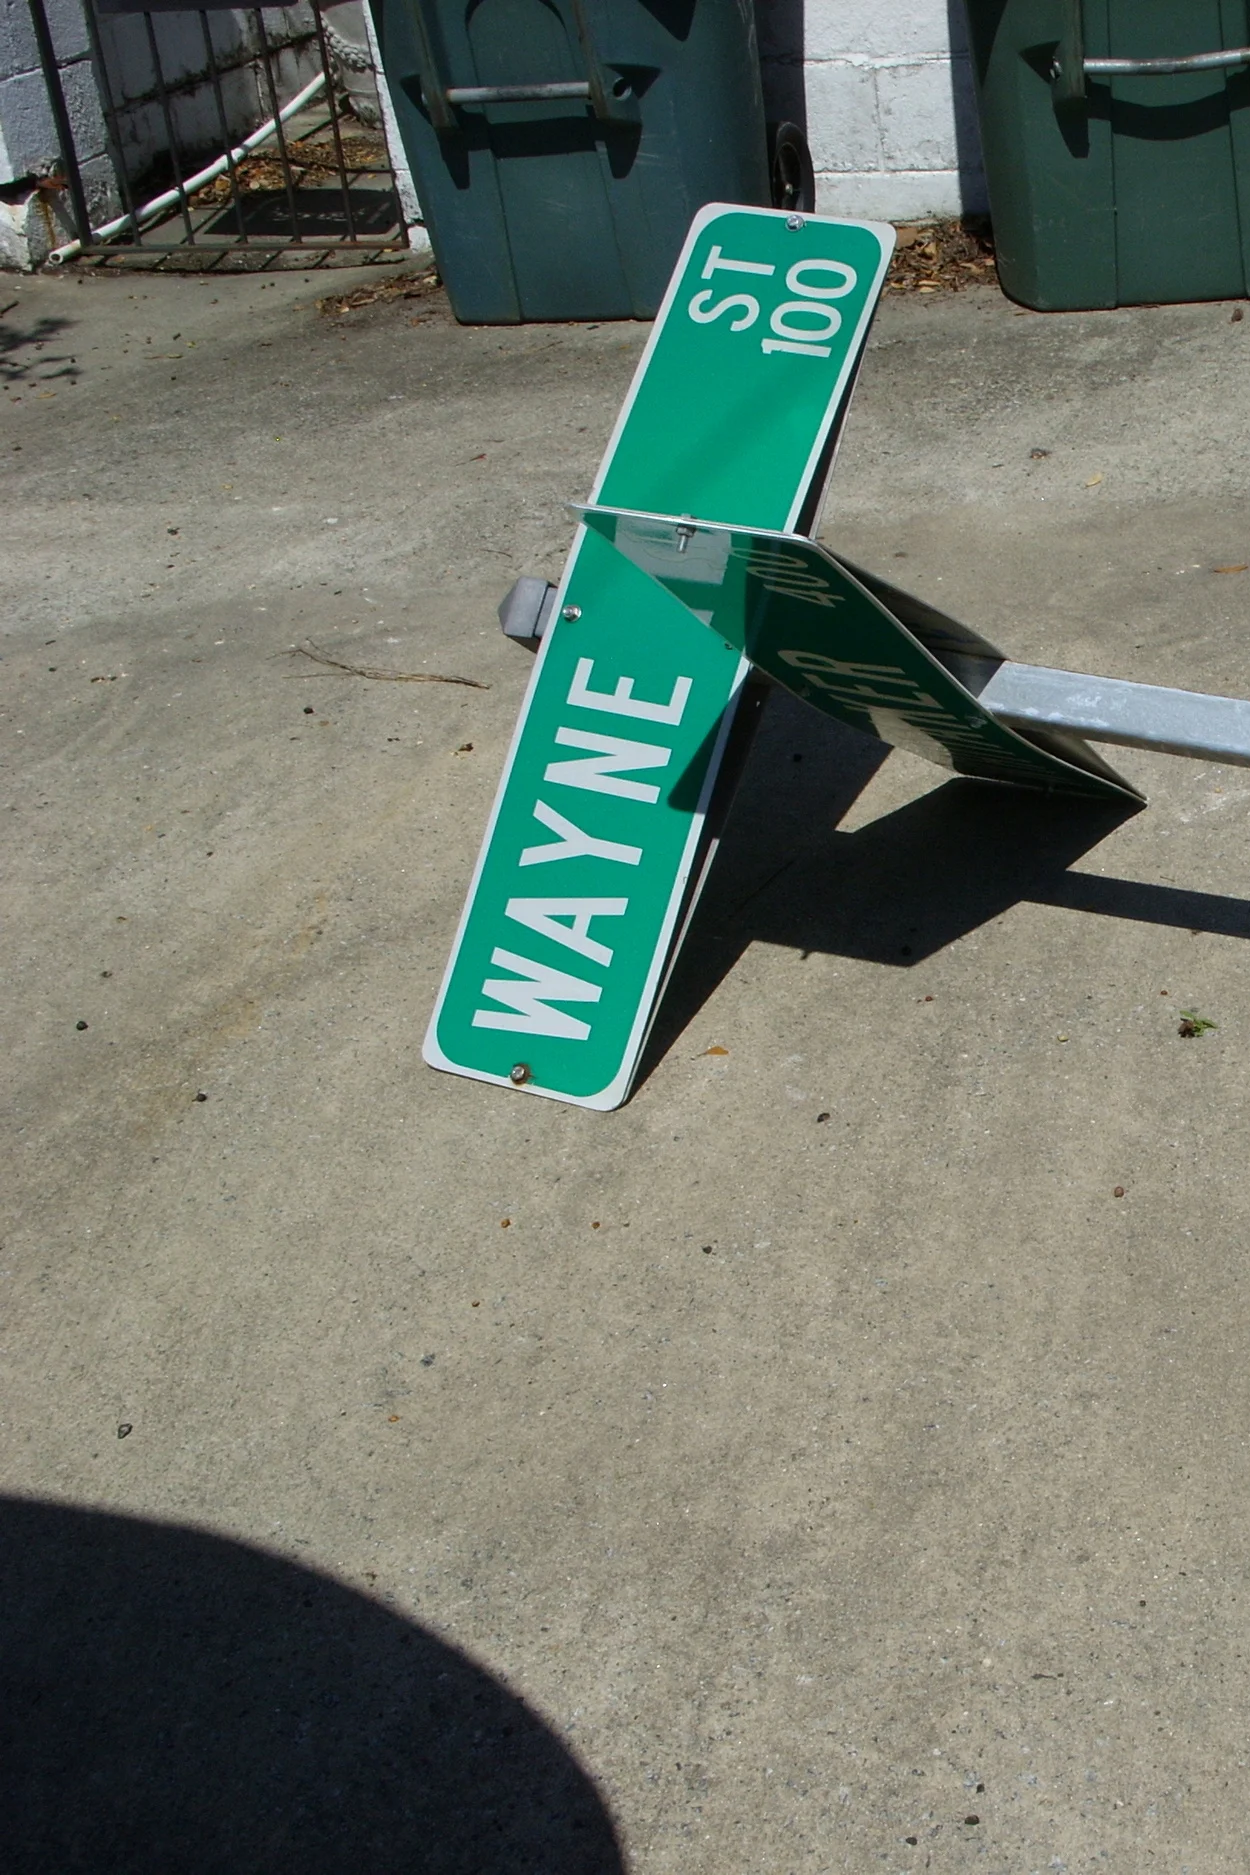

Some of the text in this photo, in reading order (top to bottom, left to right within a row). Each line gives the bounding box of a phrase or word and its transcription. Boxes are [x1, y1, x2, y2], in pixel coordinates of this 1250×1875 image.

[688, 245, 776, 332] ST
[760, 259, 858, 358] 100
[727, 546, 846, 608] 400
[471, 657, 694, 1041] WAYNE
